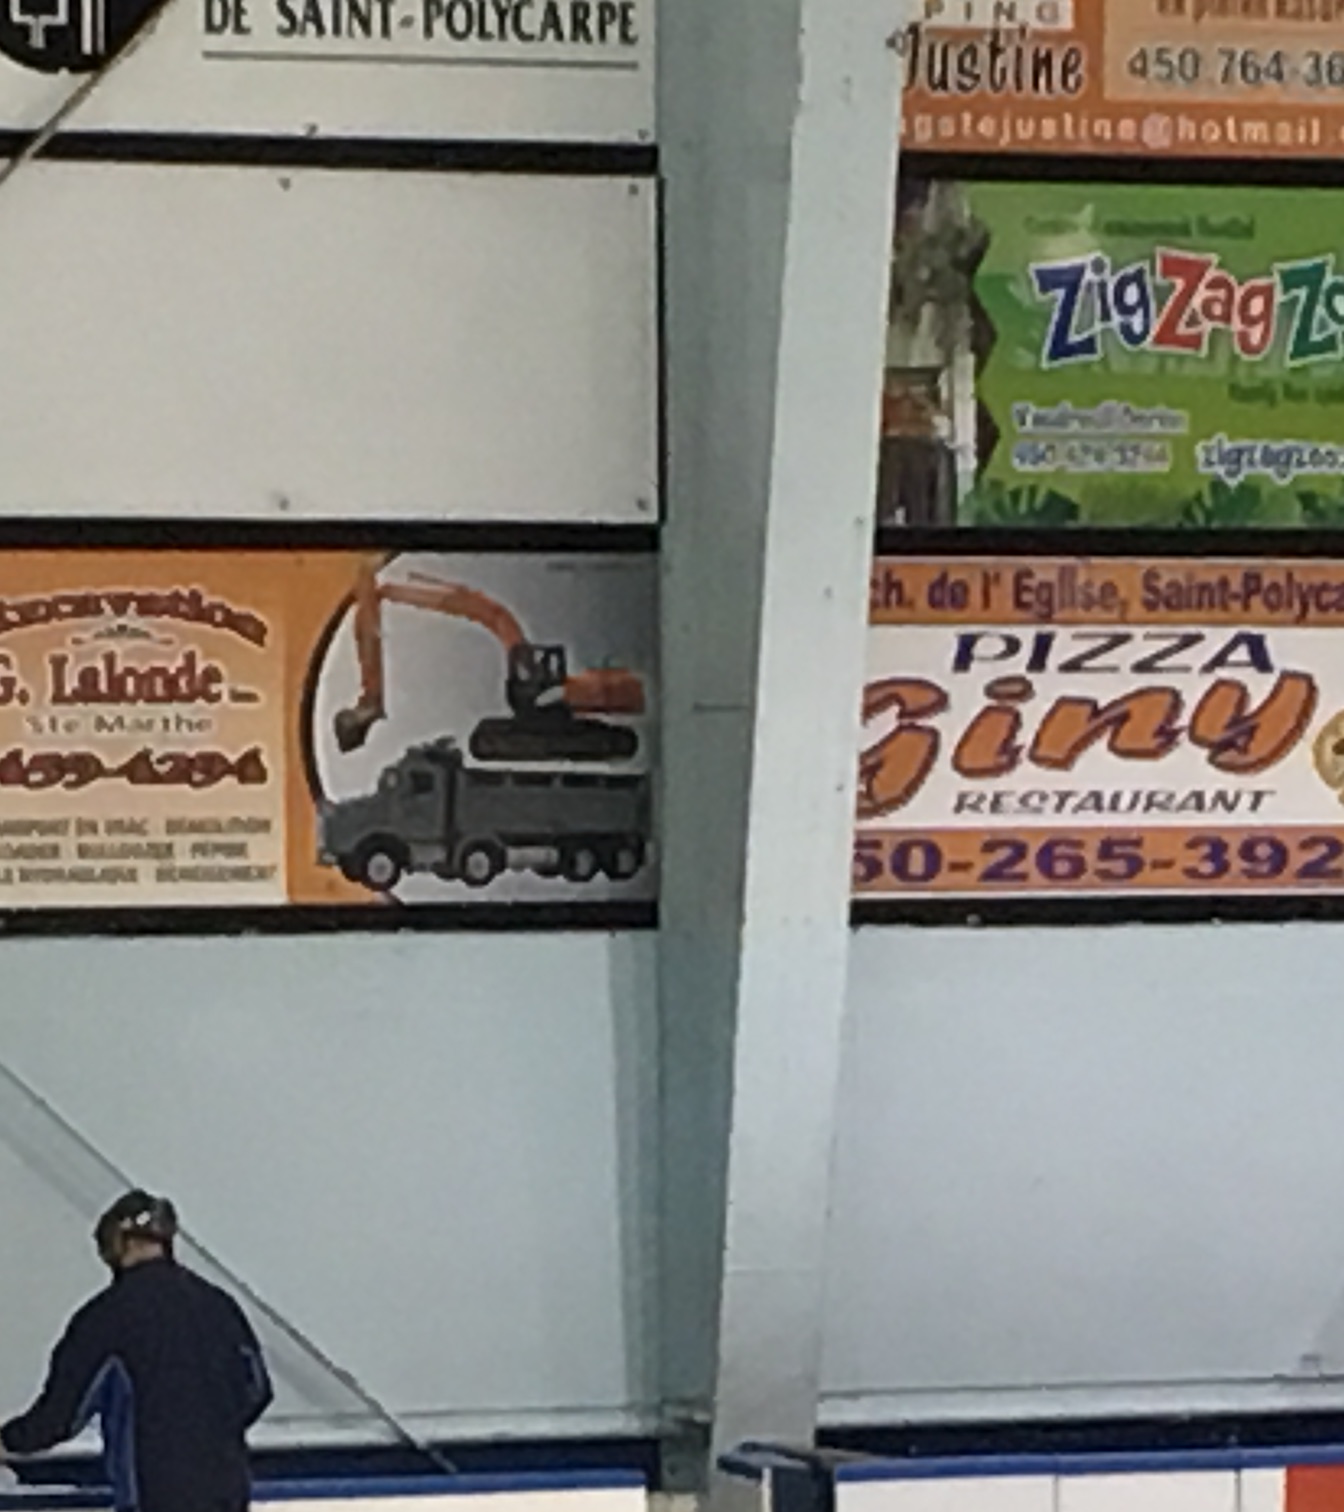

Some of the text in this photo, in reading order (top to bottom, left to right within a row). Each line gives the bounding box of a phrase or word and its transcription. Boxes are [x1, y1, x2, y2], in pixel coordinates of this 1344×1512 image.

[204, 0, 638, 43] DE SAINT-POLYCARPE
[1127, 46, 1200, 83] 450
[926, 570, 970, 611] de
[951, 631, 1276, 675] PIZZA
[48, 649, 224, 707] Lalonde
[952, 788, 1278, 815] RESTAURANT
